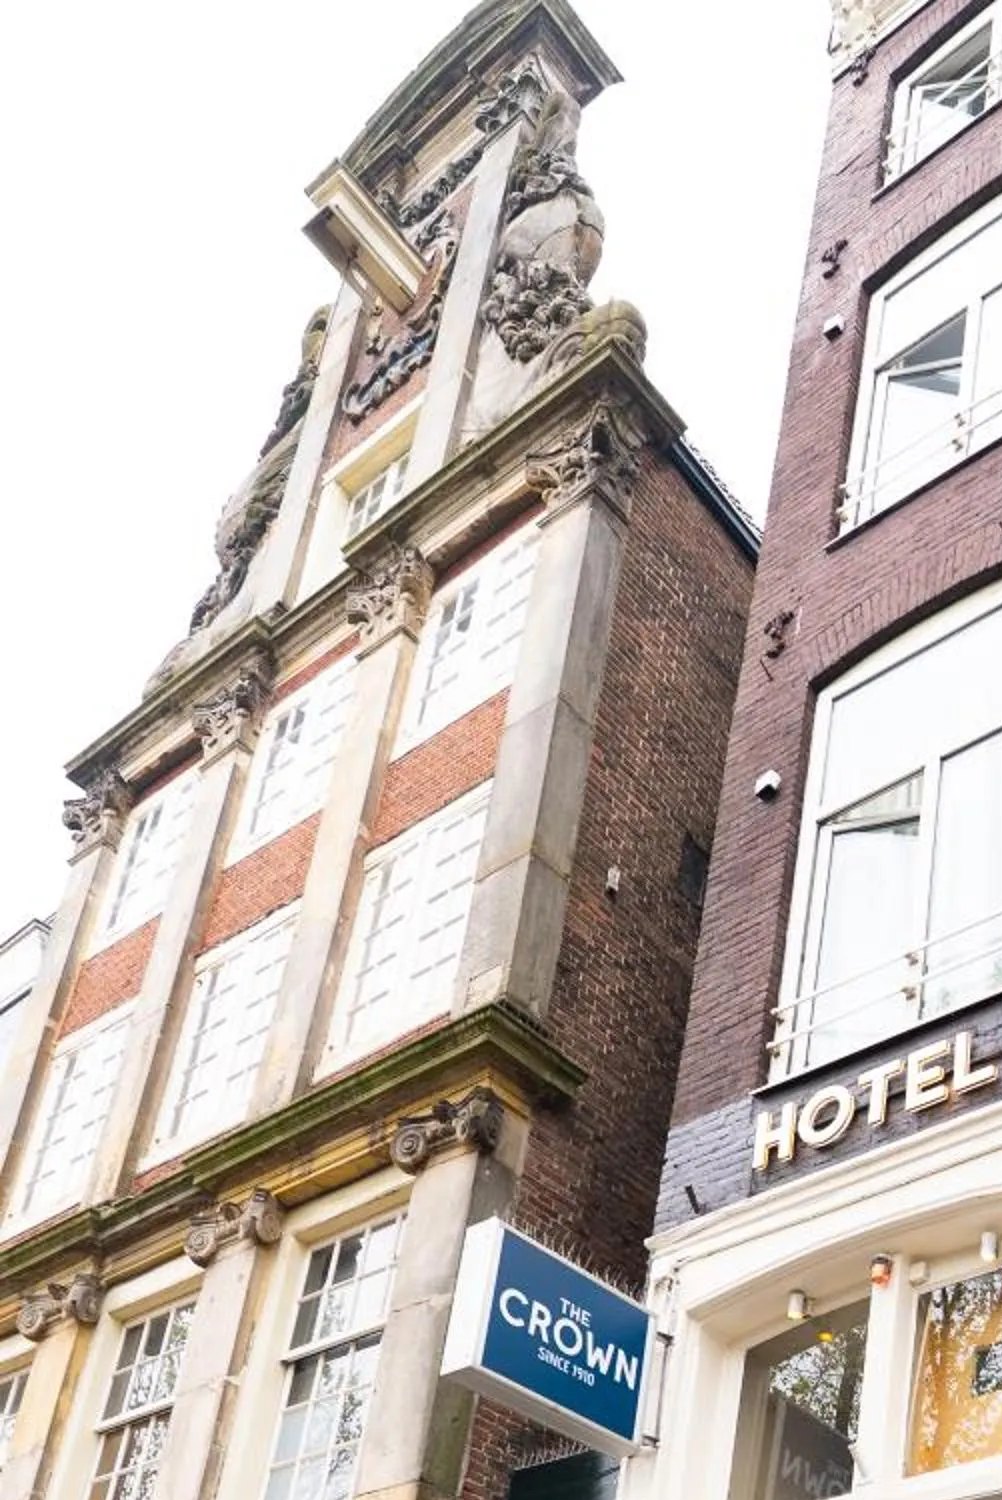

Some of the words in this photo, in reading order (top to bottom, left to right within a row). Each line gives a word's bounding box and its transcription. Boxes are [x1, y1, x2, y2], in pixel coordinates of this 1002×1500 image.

[752, 1031, 997, 1171] HOTEL
[500, 1287, 639, 1391] CROWN
[559, 1297, 593, 1328] THE
[537, 1347, 570, 1374] SINCE
[572, 1364, 595, 1387] 1910
